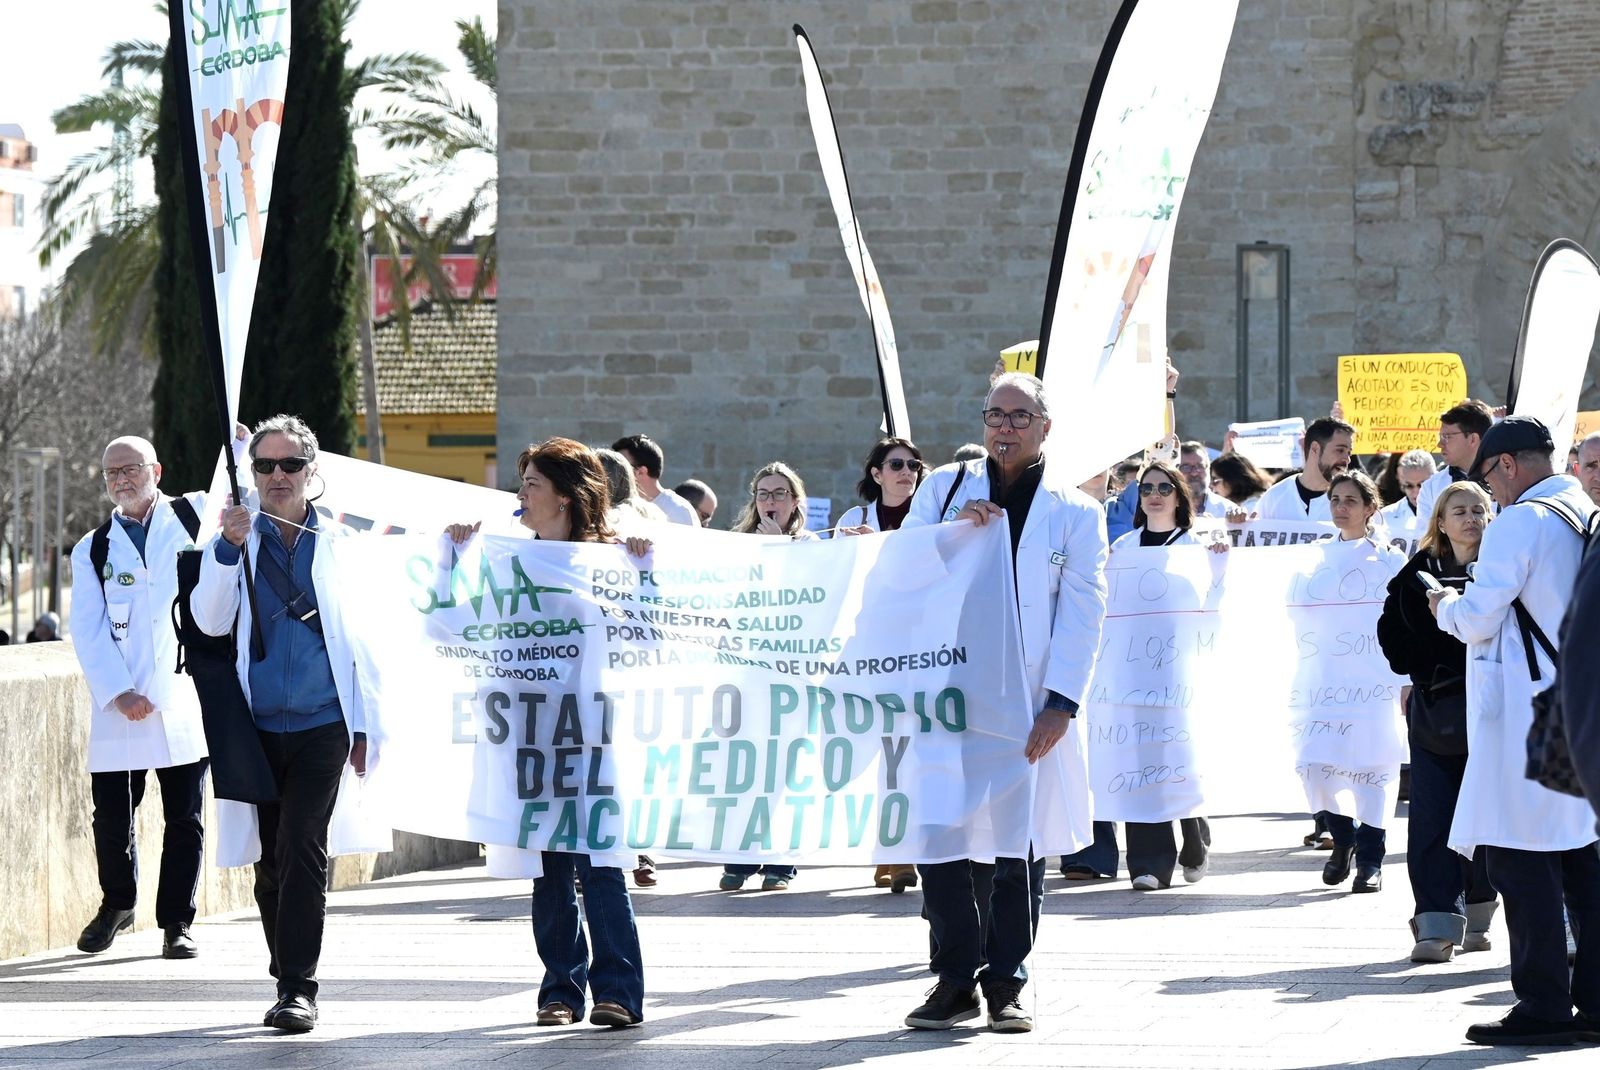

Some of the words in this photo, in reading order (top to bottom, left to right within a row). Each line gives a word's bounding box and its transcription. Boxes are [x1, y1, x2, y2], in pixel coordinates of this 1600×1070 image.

[1362, 361, 1380, 374] UN
[1385, 360, 1460, 378] CONDUCTOR
[1346, 378, 1404, 393] AGOTADO
[1411, 379, 1431, 392] ES
[1437, 381, 1454, 393] UN
[1354, 397, 1404, 410] PELIGRO
[1368, 432, 1388, 442] UNA
[592, 569, 634, 586] POR
[592, 585, 635, 601] POR
[640, 587, 826, 610] RESPONSABILIDAD
[599, 605, 640, 621] POR
[640, 610, 732, 630] NUESTRA
[737, 614, 803, 632] SALUD
[606, 625, 648, 642] POR
[649, 628, 743, 651] NUESTRAS
[750, 637, 841, 654] FAMILIAS
[435, 645, 513, 663] SINDICATO
[517, 642, 580, 661] MÉDICO
[608, 650, 652, 669] POR
[656, 648, 681, 665] LA
[687, 651, 773, 670] DIGNIDAD
[775, 660, 800, 676] DE
[805, 661, 850, 676] UNA
[855, 643, 967, 676] PROFESIÓN
[464, 665, 483, 679] DE
[1310, 684, 1394, 708] VECINOS
[452, 684, 742, 745] ESTATUTO
[769, 684, 967, 736] PROPIO
[516, 746, 615, 800] DEL
[643, 727, 853, 796] MÉDICO
[881, 736, 911, 790] Y
[1107, 765, 1187, 794] OTROS
[517, 792, 910, 851] FACULTATIVO
